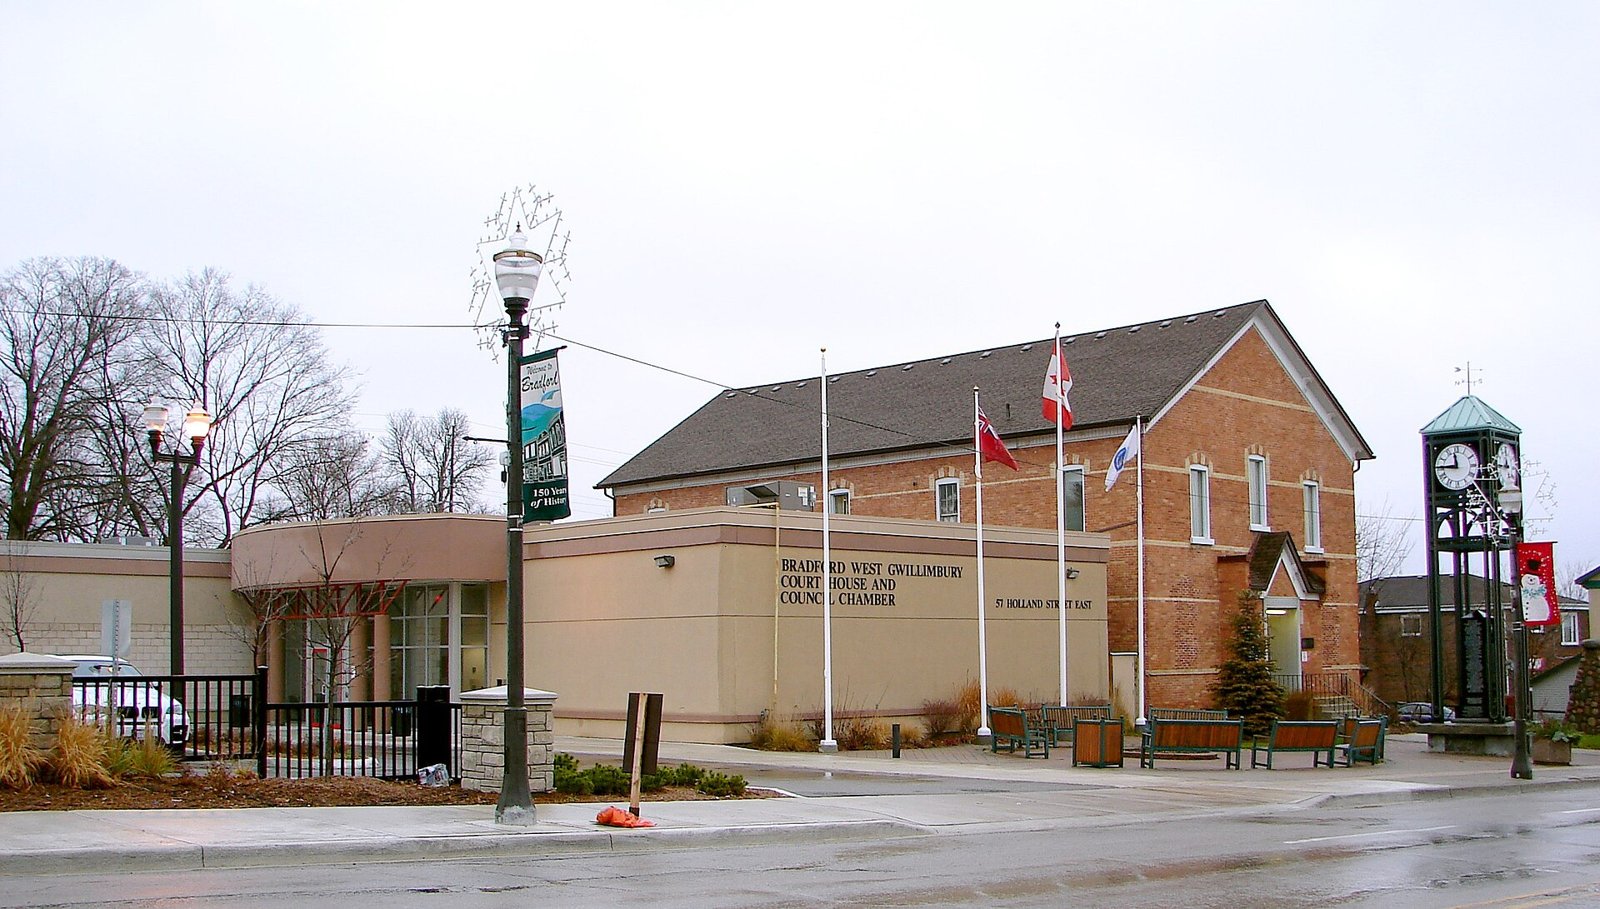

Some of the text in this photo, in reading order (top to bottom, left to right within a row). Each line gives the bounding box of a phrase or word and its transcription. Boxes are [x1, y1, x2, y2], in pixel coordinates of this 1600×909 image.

[522, 371, 558, 393] Bradford
[533, 488, 549, 497] 150
[530, 498, 543, 509] of
[850, 562, 883, 575] WEST
[888, 563, 963, 578] GWILLIMBURY
[781, 575, 896, 591] COURT HOUSE AND
[839, 592, 896, 606] CHAMBER
[995, 598, 1092, 610] 57 HOLLAND STRET EAST
